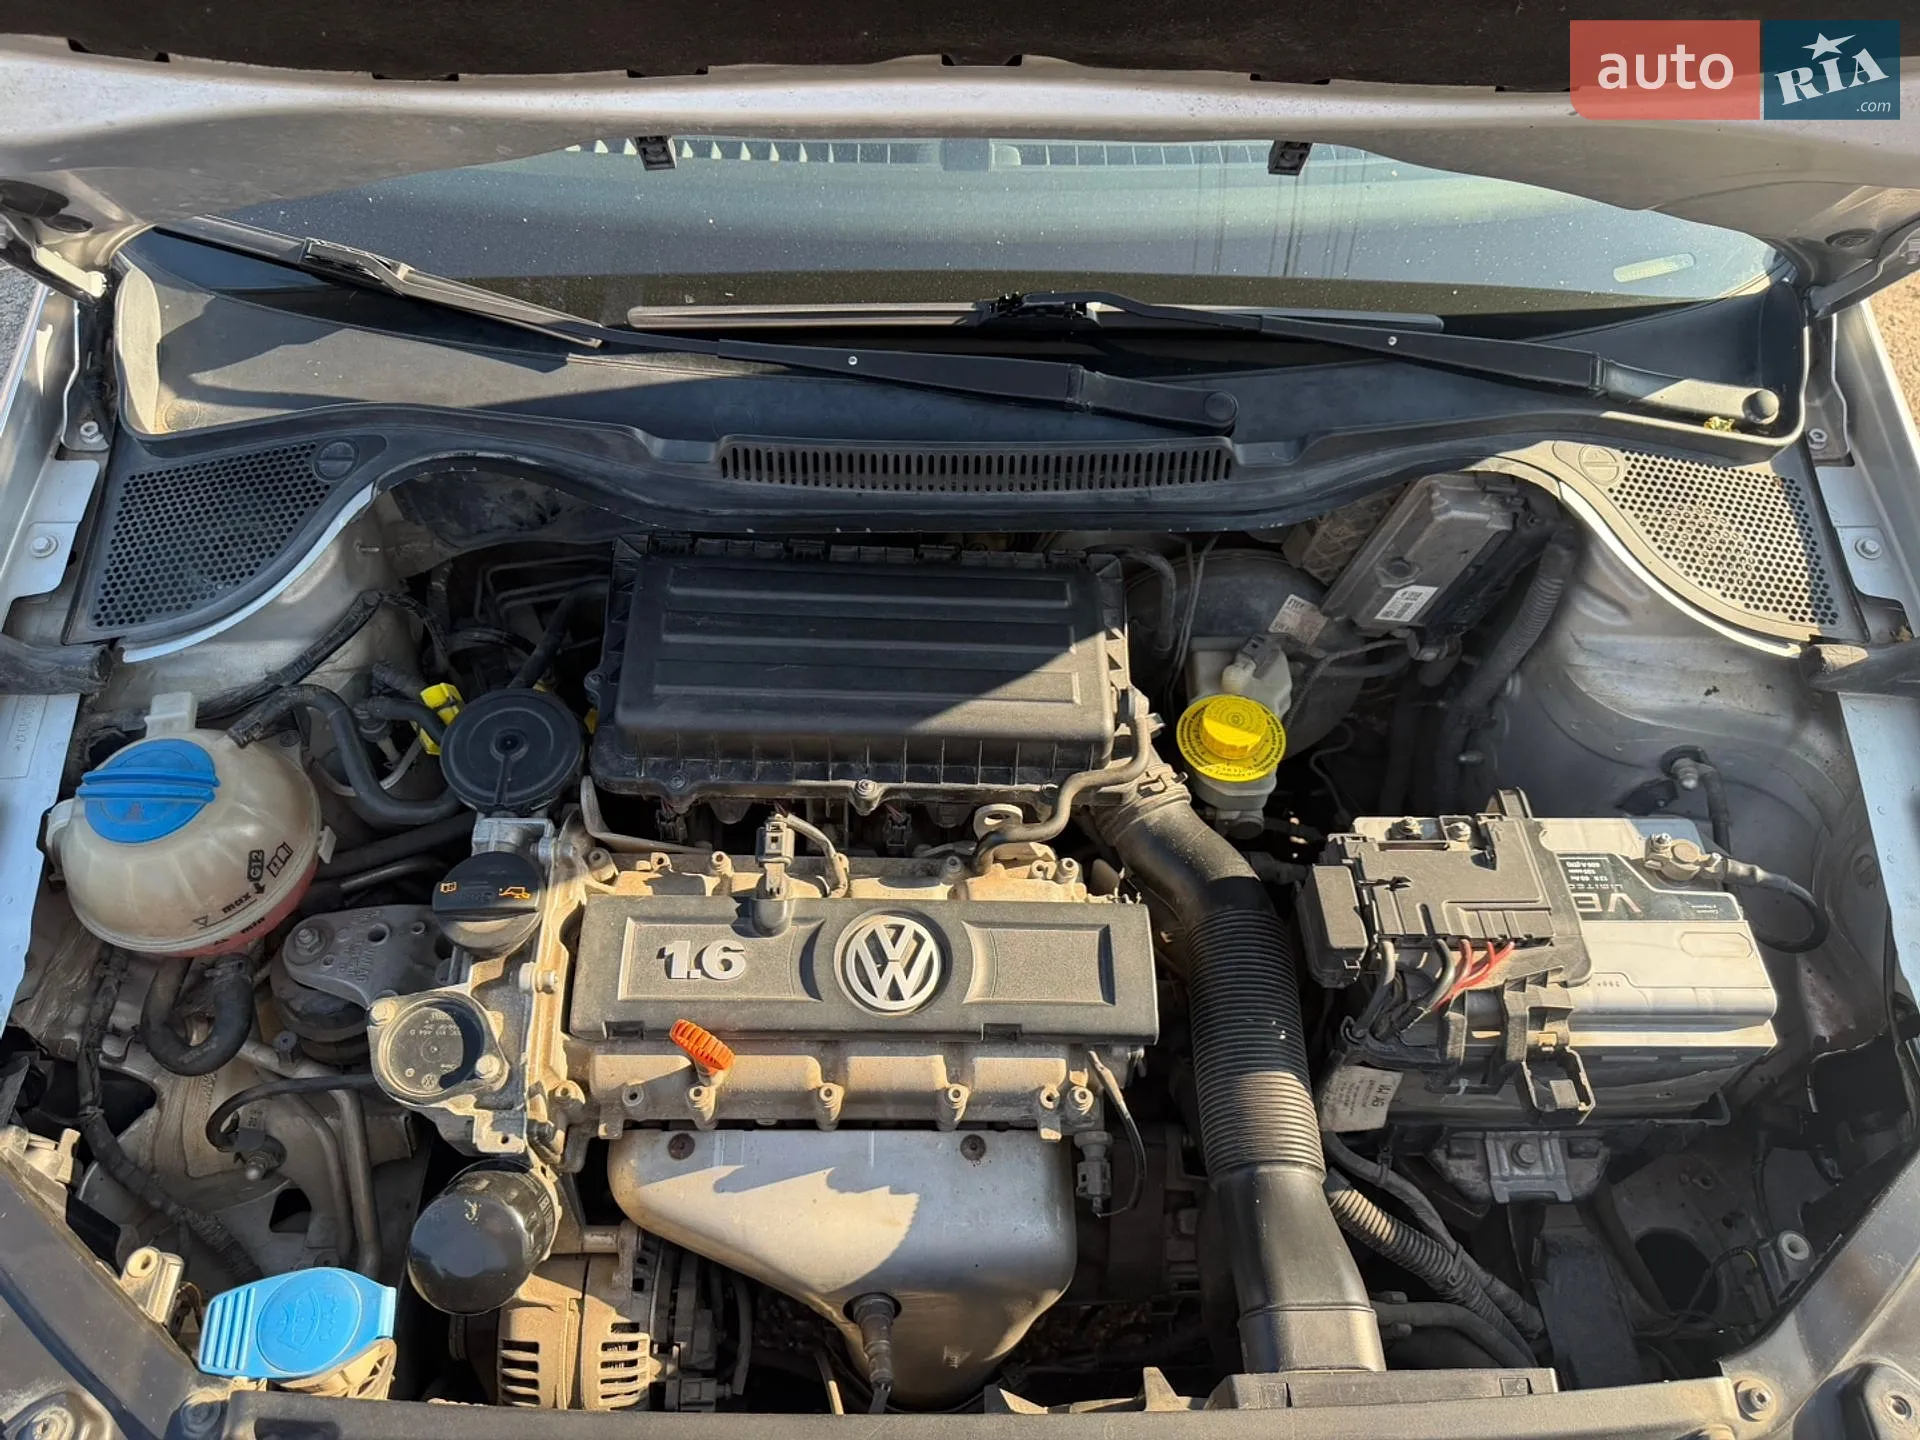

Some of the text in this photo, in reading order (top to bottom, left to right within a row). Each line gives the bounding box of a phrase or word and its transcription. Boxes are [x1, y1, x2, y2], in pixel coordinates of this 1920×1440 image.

[222, 892, 252, 914] max
[664, 939, 746, 981] 1.6
[850, 917, 937, 1007] VW
